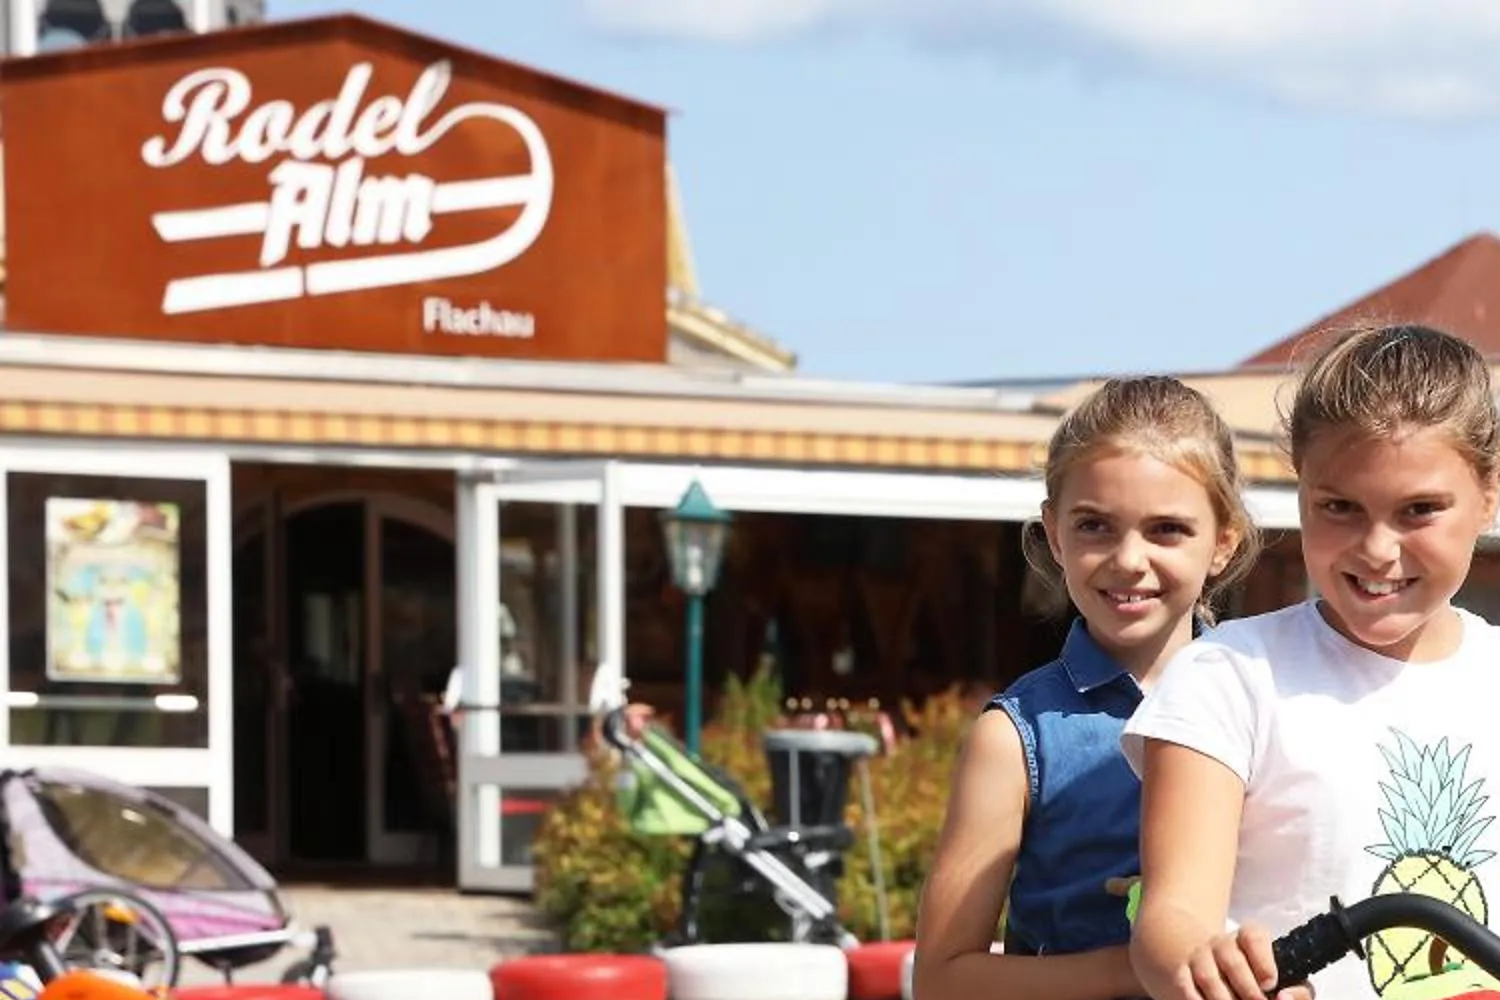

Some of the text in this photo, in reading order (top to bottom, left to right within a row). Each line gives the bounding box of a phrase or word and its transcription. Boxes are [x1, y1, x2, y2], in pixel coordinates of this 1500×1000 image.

[141, 57, 453, 168] Rodel
[259, 155, 436, 268] Alm
[422, 296, 536, 338] Flachau
